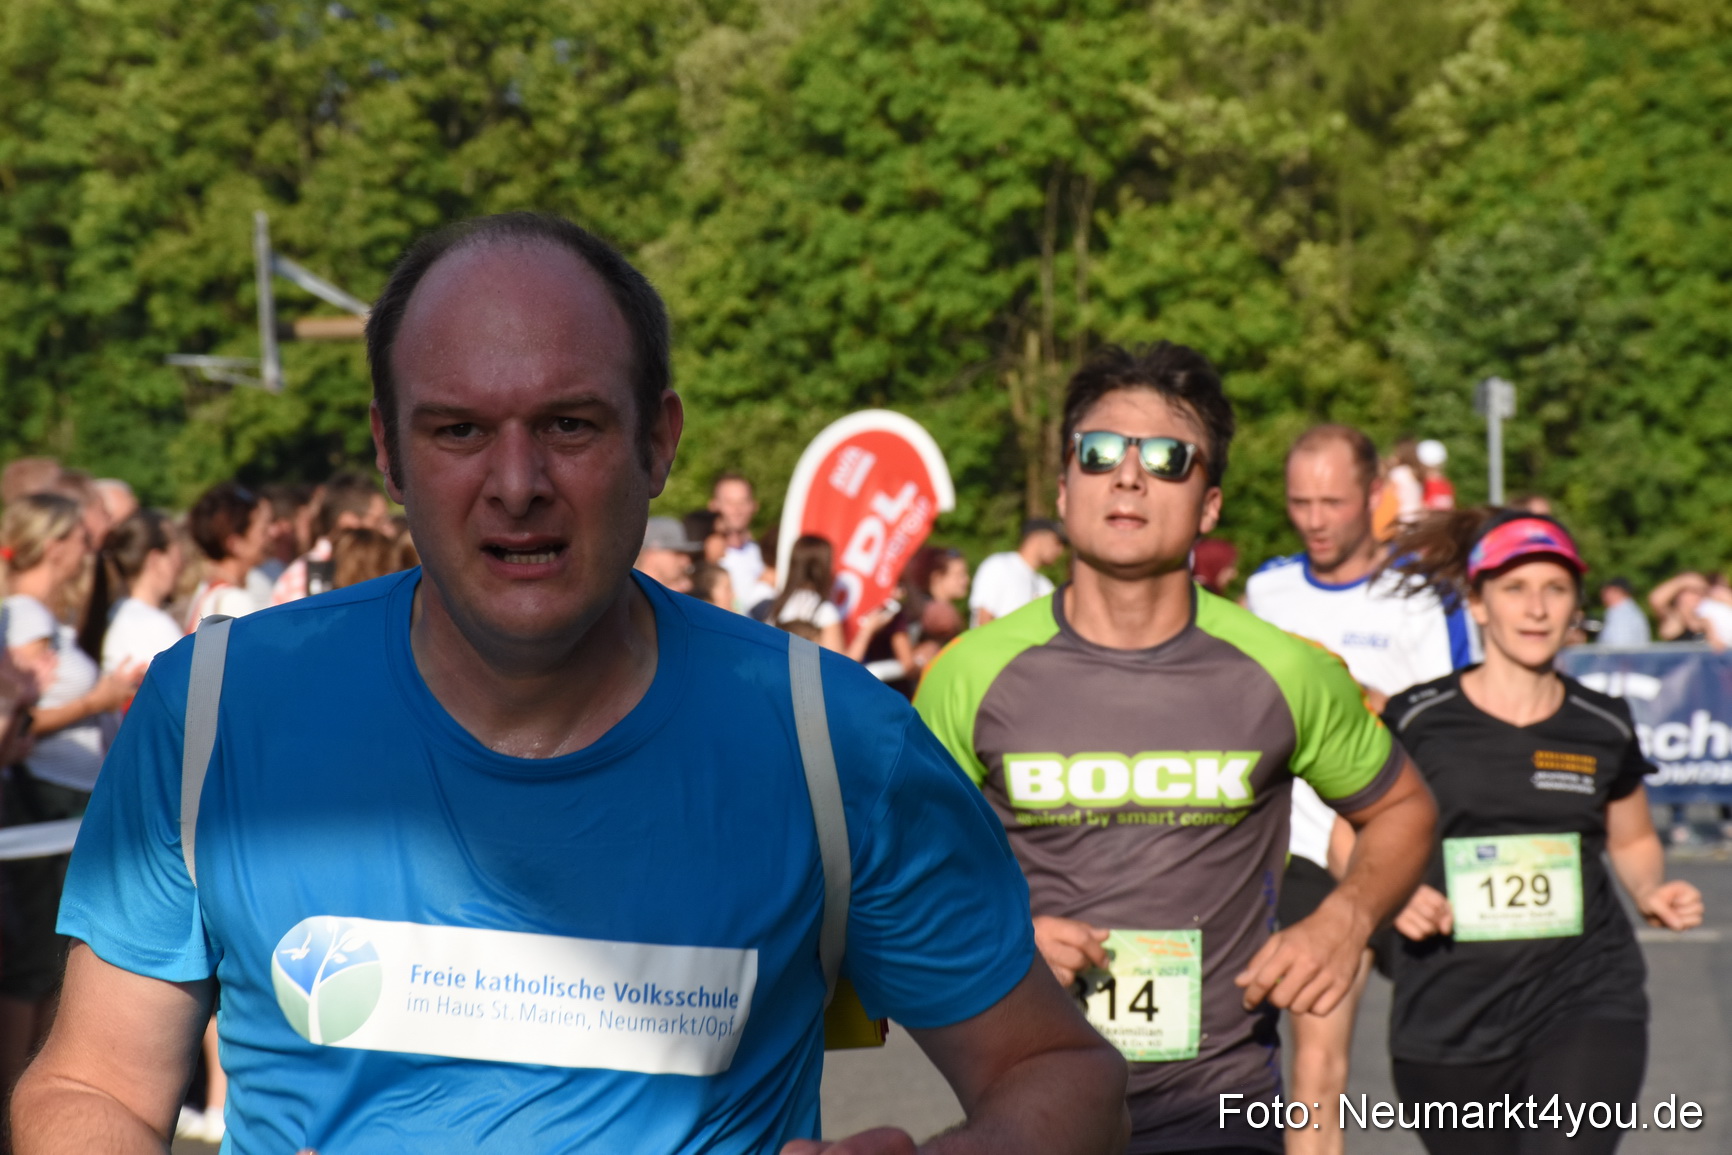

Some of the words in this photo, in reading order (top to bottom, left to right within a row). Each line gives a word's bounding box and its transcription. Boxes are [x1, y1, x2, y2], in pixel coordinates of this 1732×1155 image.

[1004, 752, 1260, 807] BOCK
[1117, 811, 1175, 827] smart
[1480, 874, 1551, 909] 129
[410, 964, 466, 988] Freie
[475, 969, 606, 1001] katholische
[614, 982, 739, 1009] Volksschule
[407, 992, 430, 1013] im
[437, 995, 485, 1019] Haus
[491, 1000, 514, 1021] St.
[519, 1002, 592, 1031] Marien,
[600, 1010, 737, 1042] Neumarkt/Opf.
